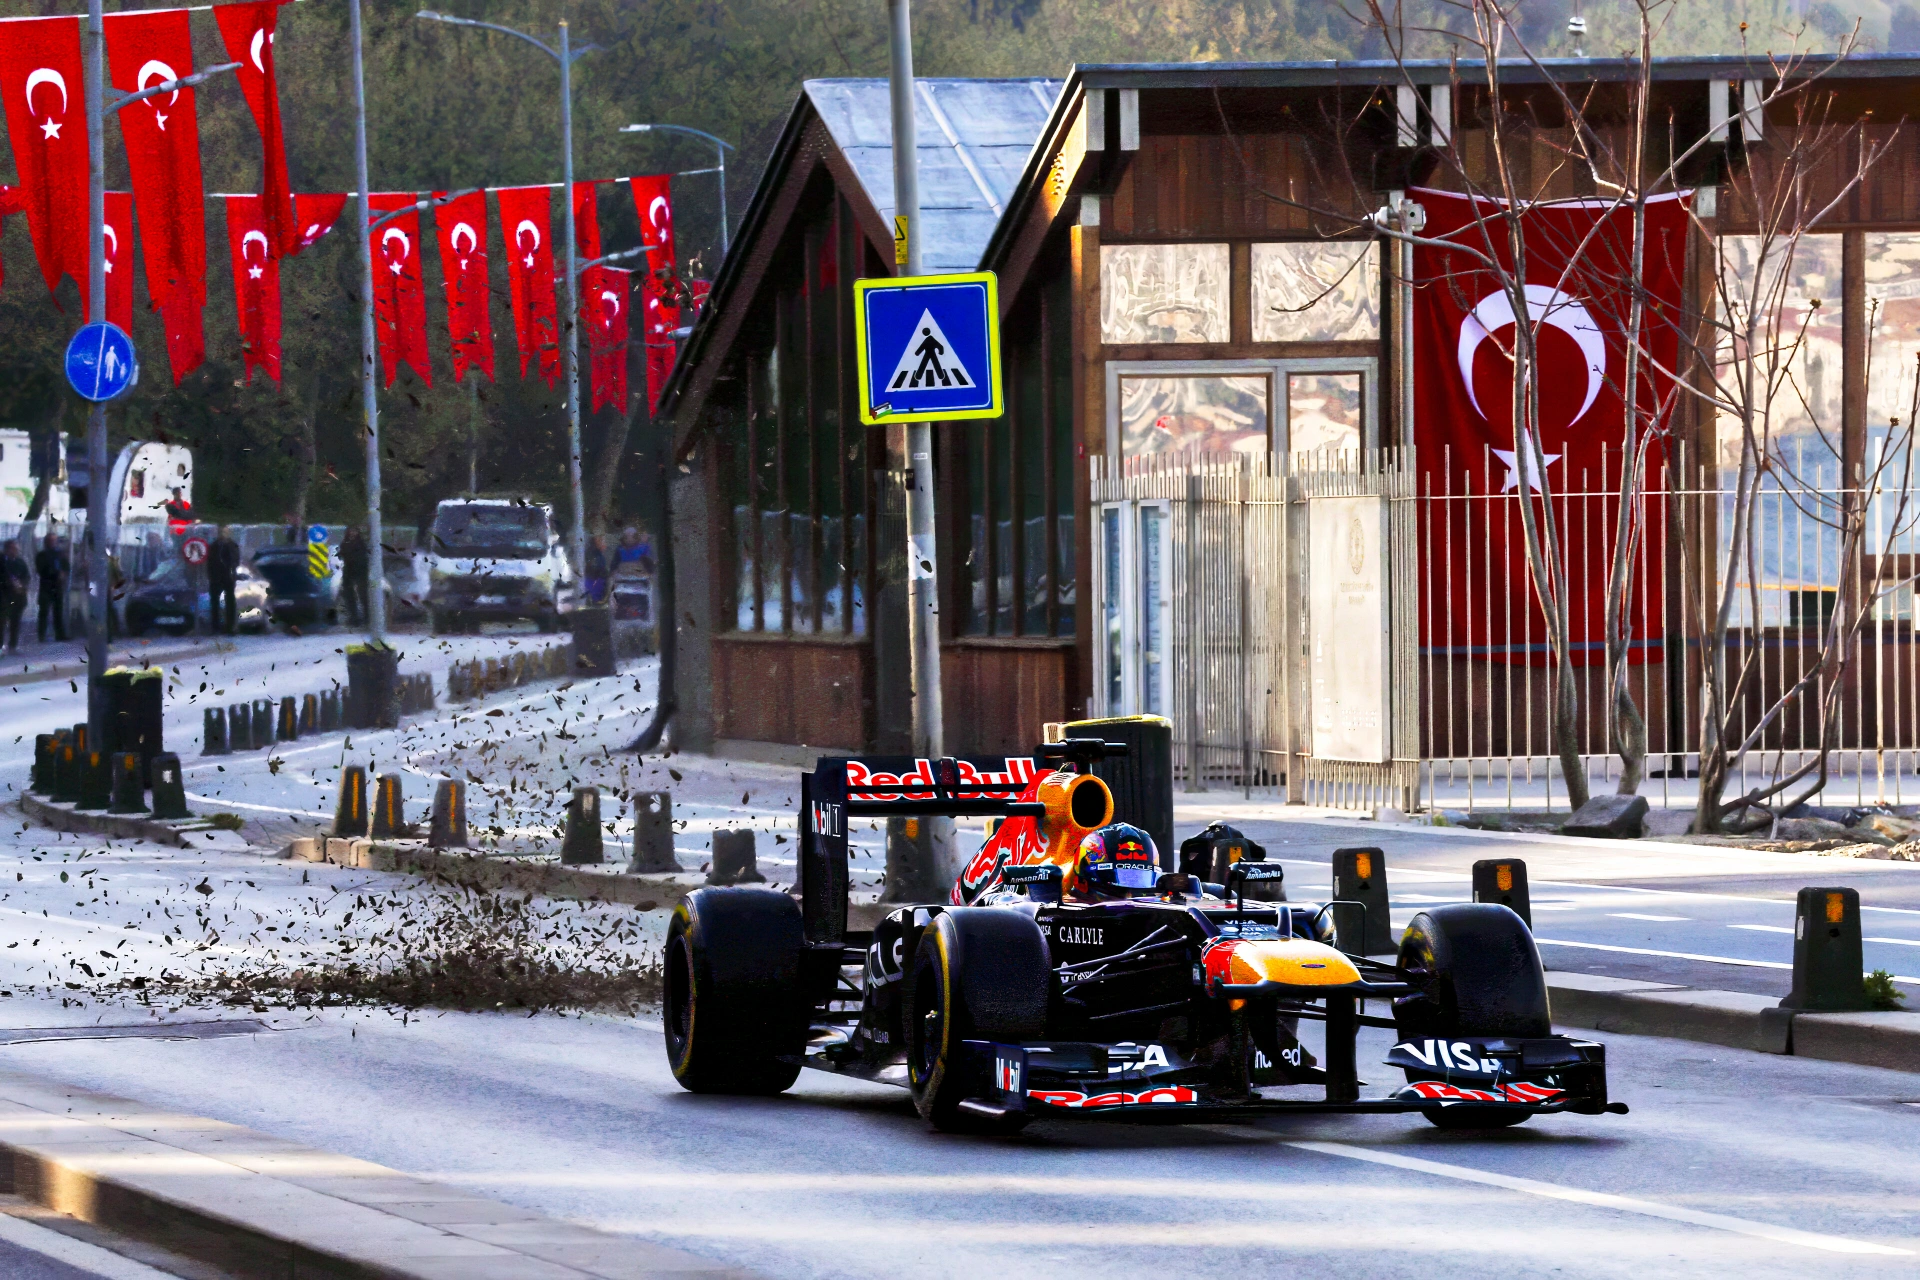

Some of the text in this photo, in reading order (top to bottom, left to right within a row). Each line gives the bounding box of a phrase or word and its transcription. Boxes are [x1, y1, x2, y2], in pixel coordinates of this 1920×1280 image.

[847, 757, 1037, 801] Red Bull
[812, 800, 831, 836] Mobil
[1115, 863, 1153, 871] ORACLE
[1059, 926, 1104, 945] CARLYLE
[1393, 1038, 1512, 1075] VISA
[996, 1057, 1020, 1093] Mobil
[1027, 1084, 1198, 1107] Red
